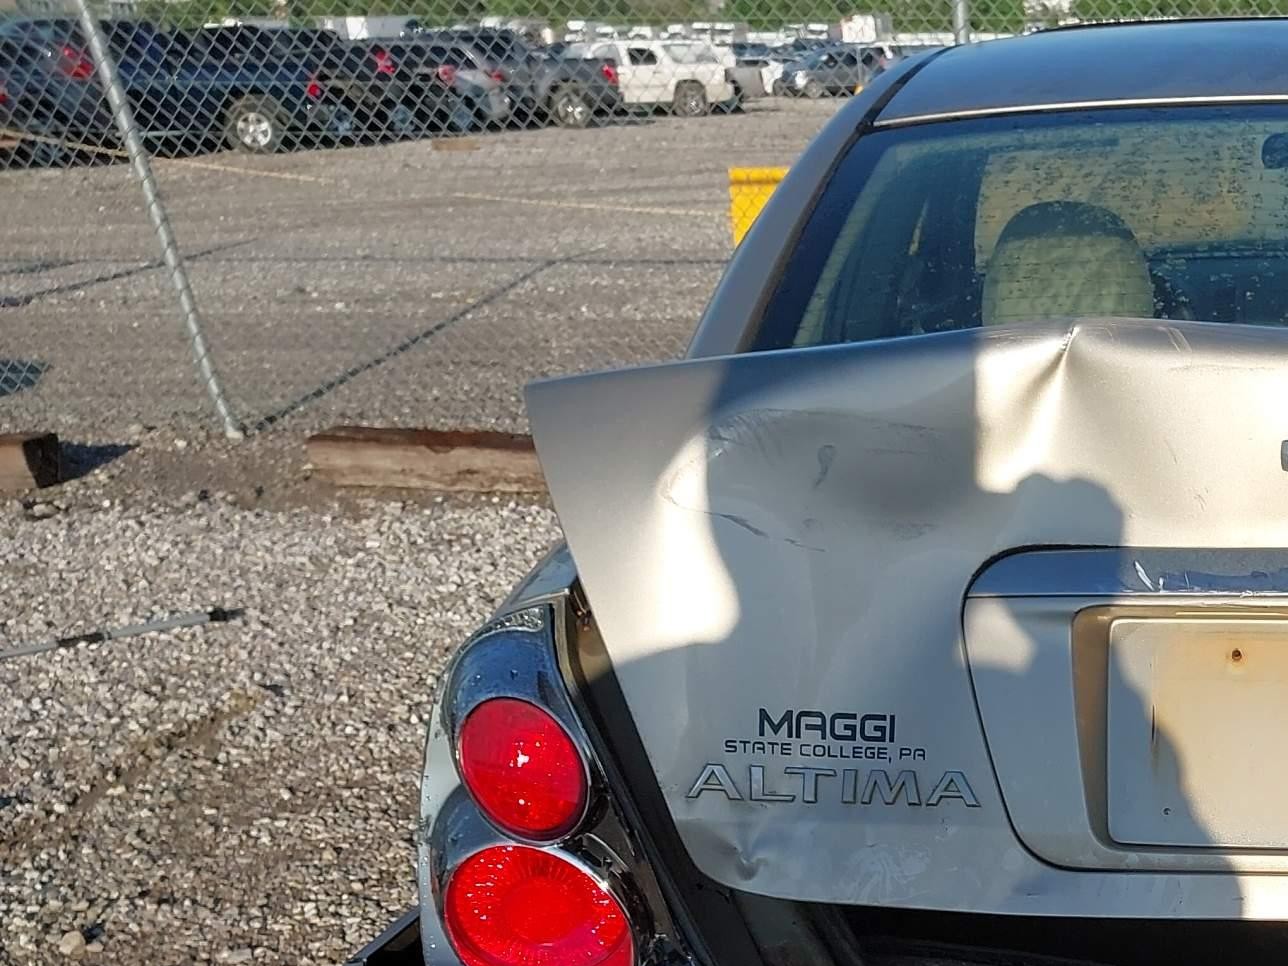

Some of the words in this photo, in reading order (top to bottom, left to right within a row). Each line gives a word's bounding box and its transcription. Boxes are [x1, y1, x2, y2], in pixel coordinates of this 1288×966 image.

[758, 708, 896, 743] MAGGI
[724, 739, 793, 756] STATE
[799, 744, 894, 764] COLLEGE,
[899, 748, 927, 761] PA
[685, 763, 982, 808] ALTIMA
